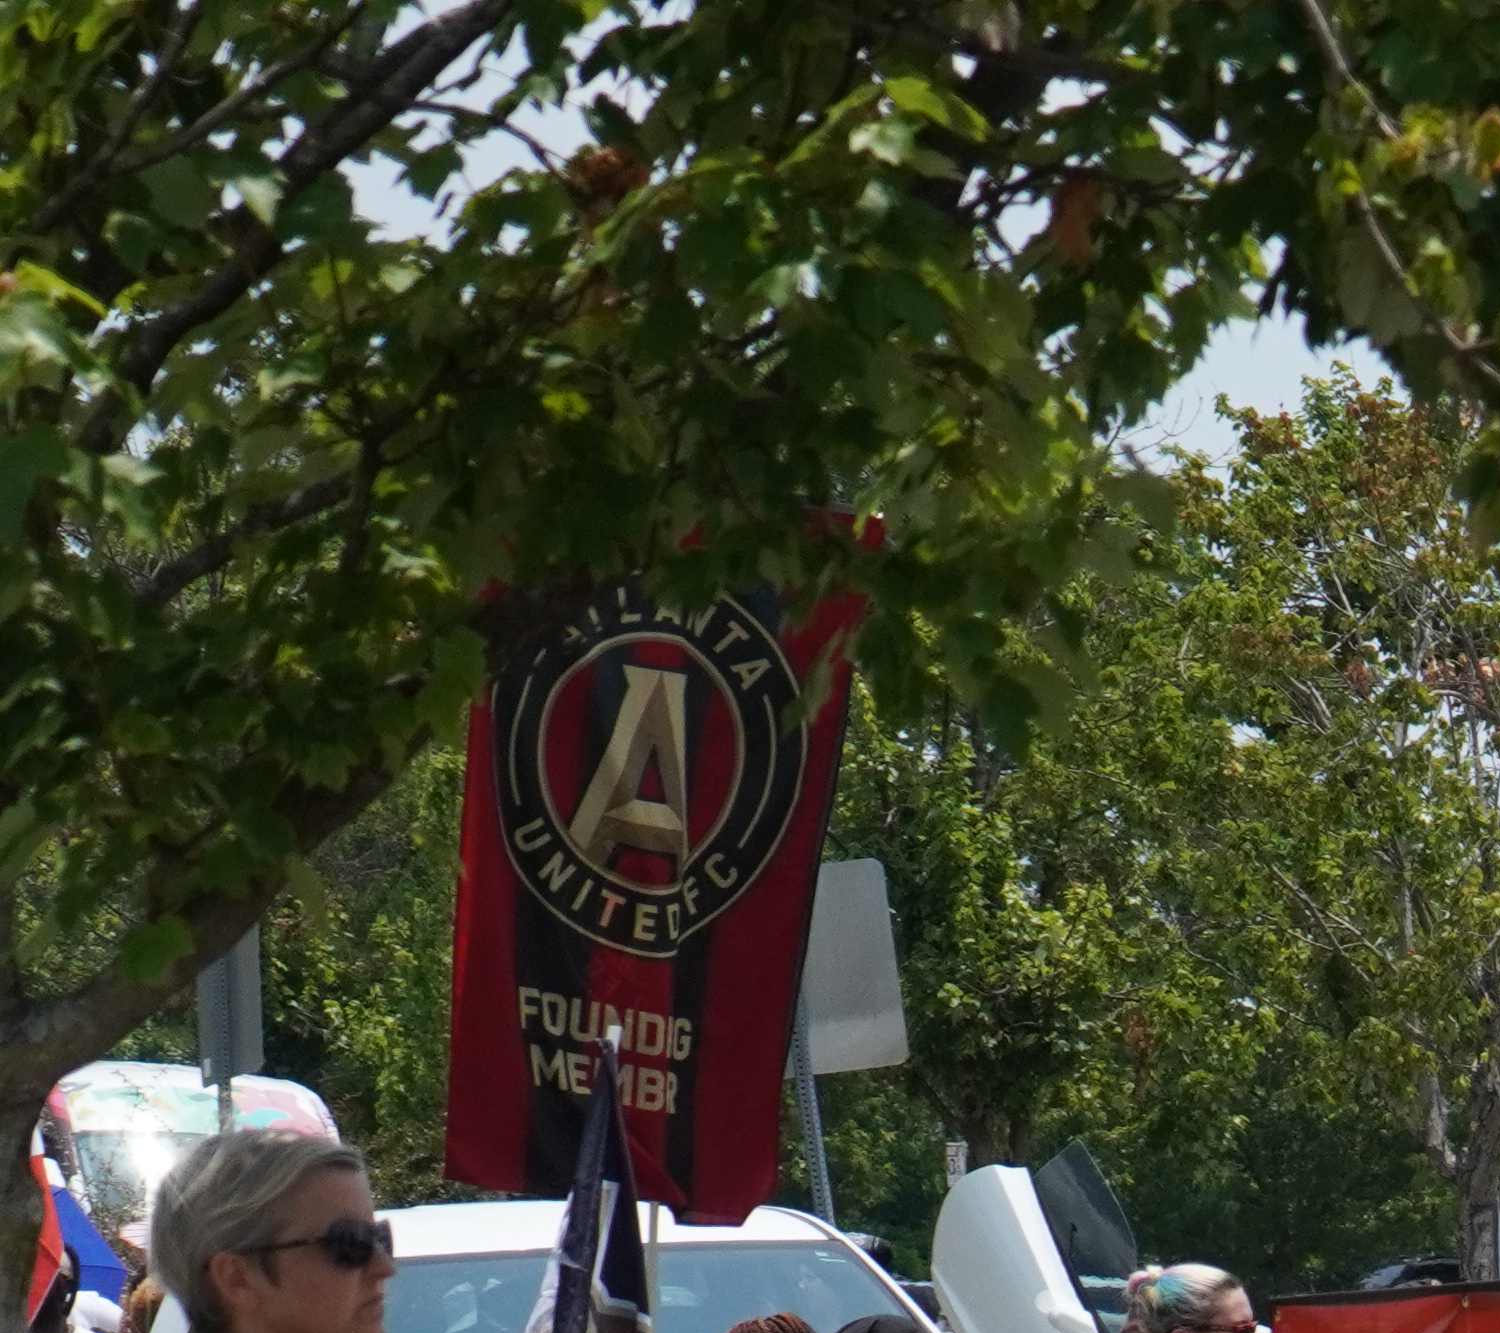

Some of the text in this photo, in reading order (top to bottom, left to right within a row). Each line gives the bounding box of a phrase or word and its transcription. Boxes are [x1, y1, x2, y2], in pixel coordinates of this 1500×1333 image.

[681, 851, 739, 916] FC
[518, 985, 692, 1062] FOUNDIG
[529, 1043, 679, 1115] MEMBR
